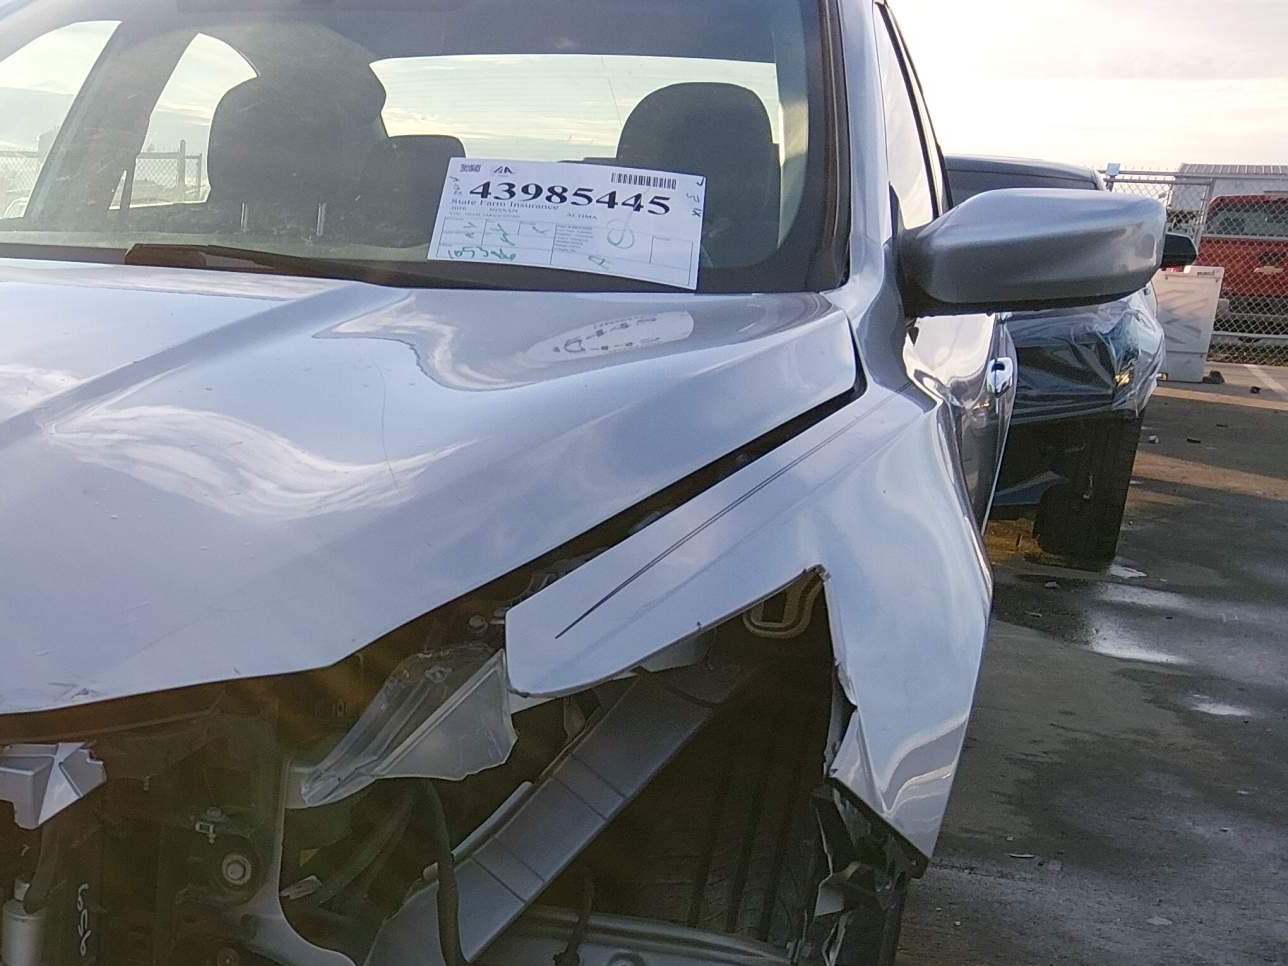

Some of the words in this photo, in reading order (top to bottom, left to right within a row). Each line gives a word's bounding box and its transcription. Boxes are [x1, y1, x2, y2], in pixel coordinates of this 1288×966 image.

[451, 198, 476, 206] State
[479, 199, 506, 207] Farm
[510, 201, 560, 210] Insurance
[469, 180, 672, 216] 43985445
